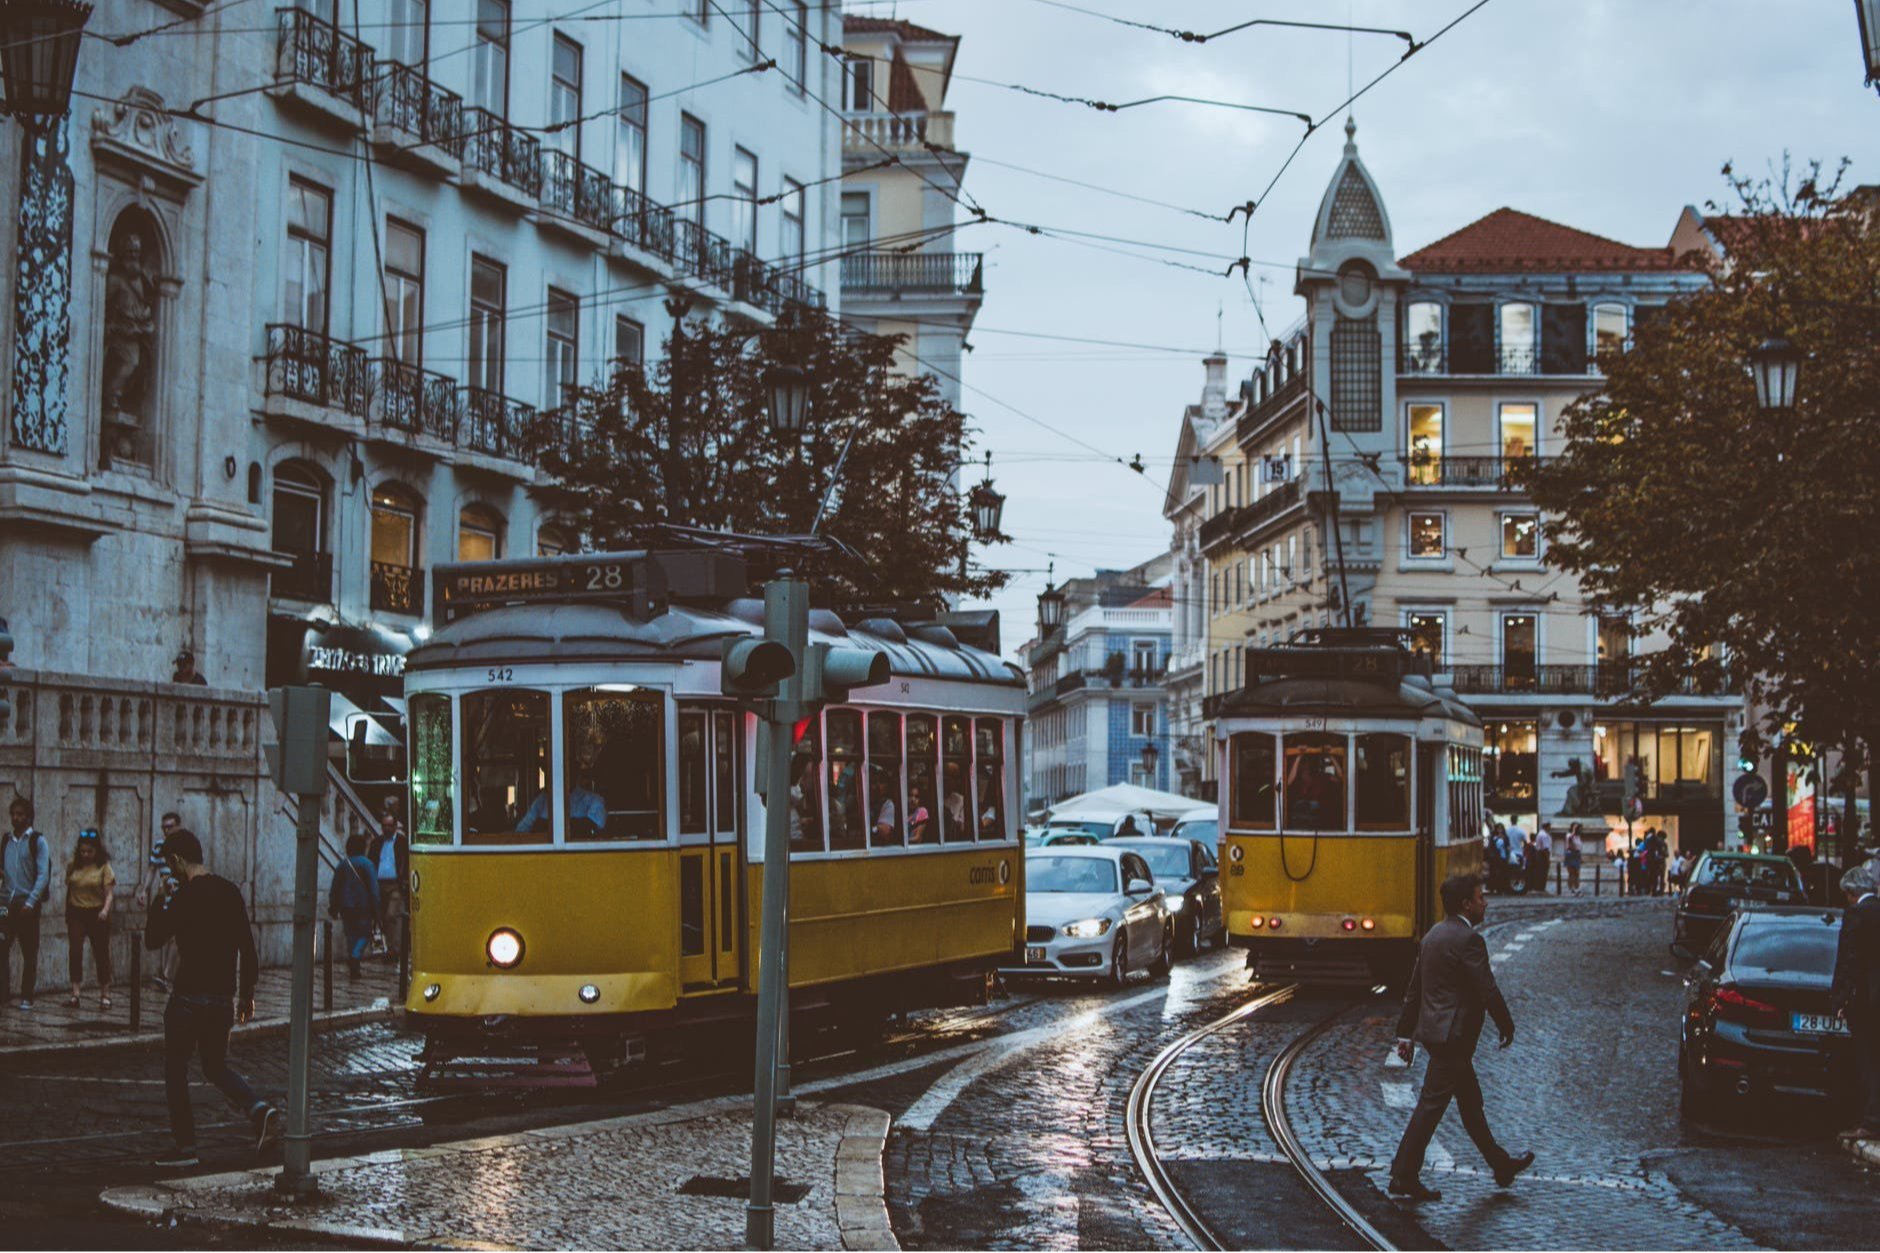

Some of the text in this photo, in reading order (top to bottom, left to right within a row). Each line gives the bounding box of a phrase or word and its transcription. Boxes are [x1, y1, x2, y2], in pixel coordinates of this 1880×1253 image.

[457, 565, 622, 593] PRAZERES 28
[488, 668, 513, 682] 542
